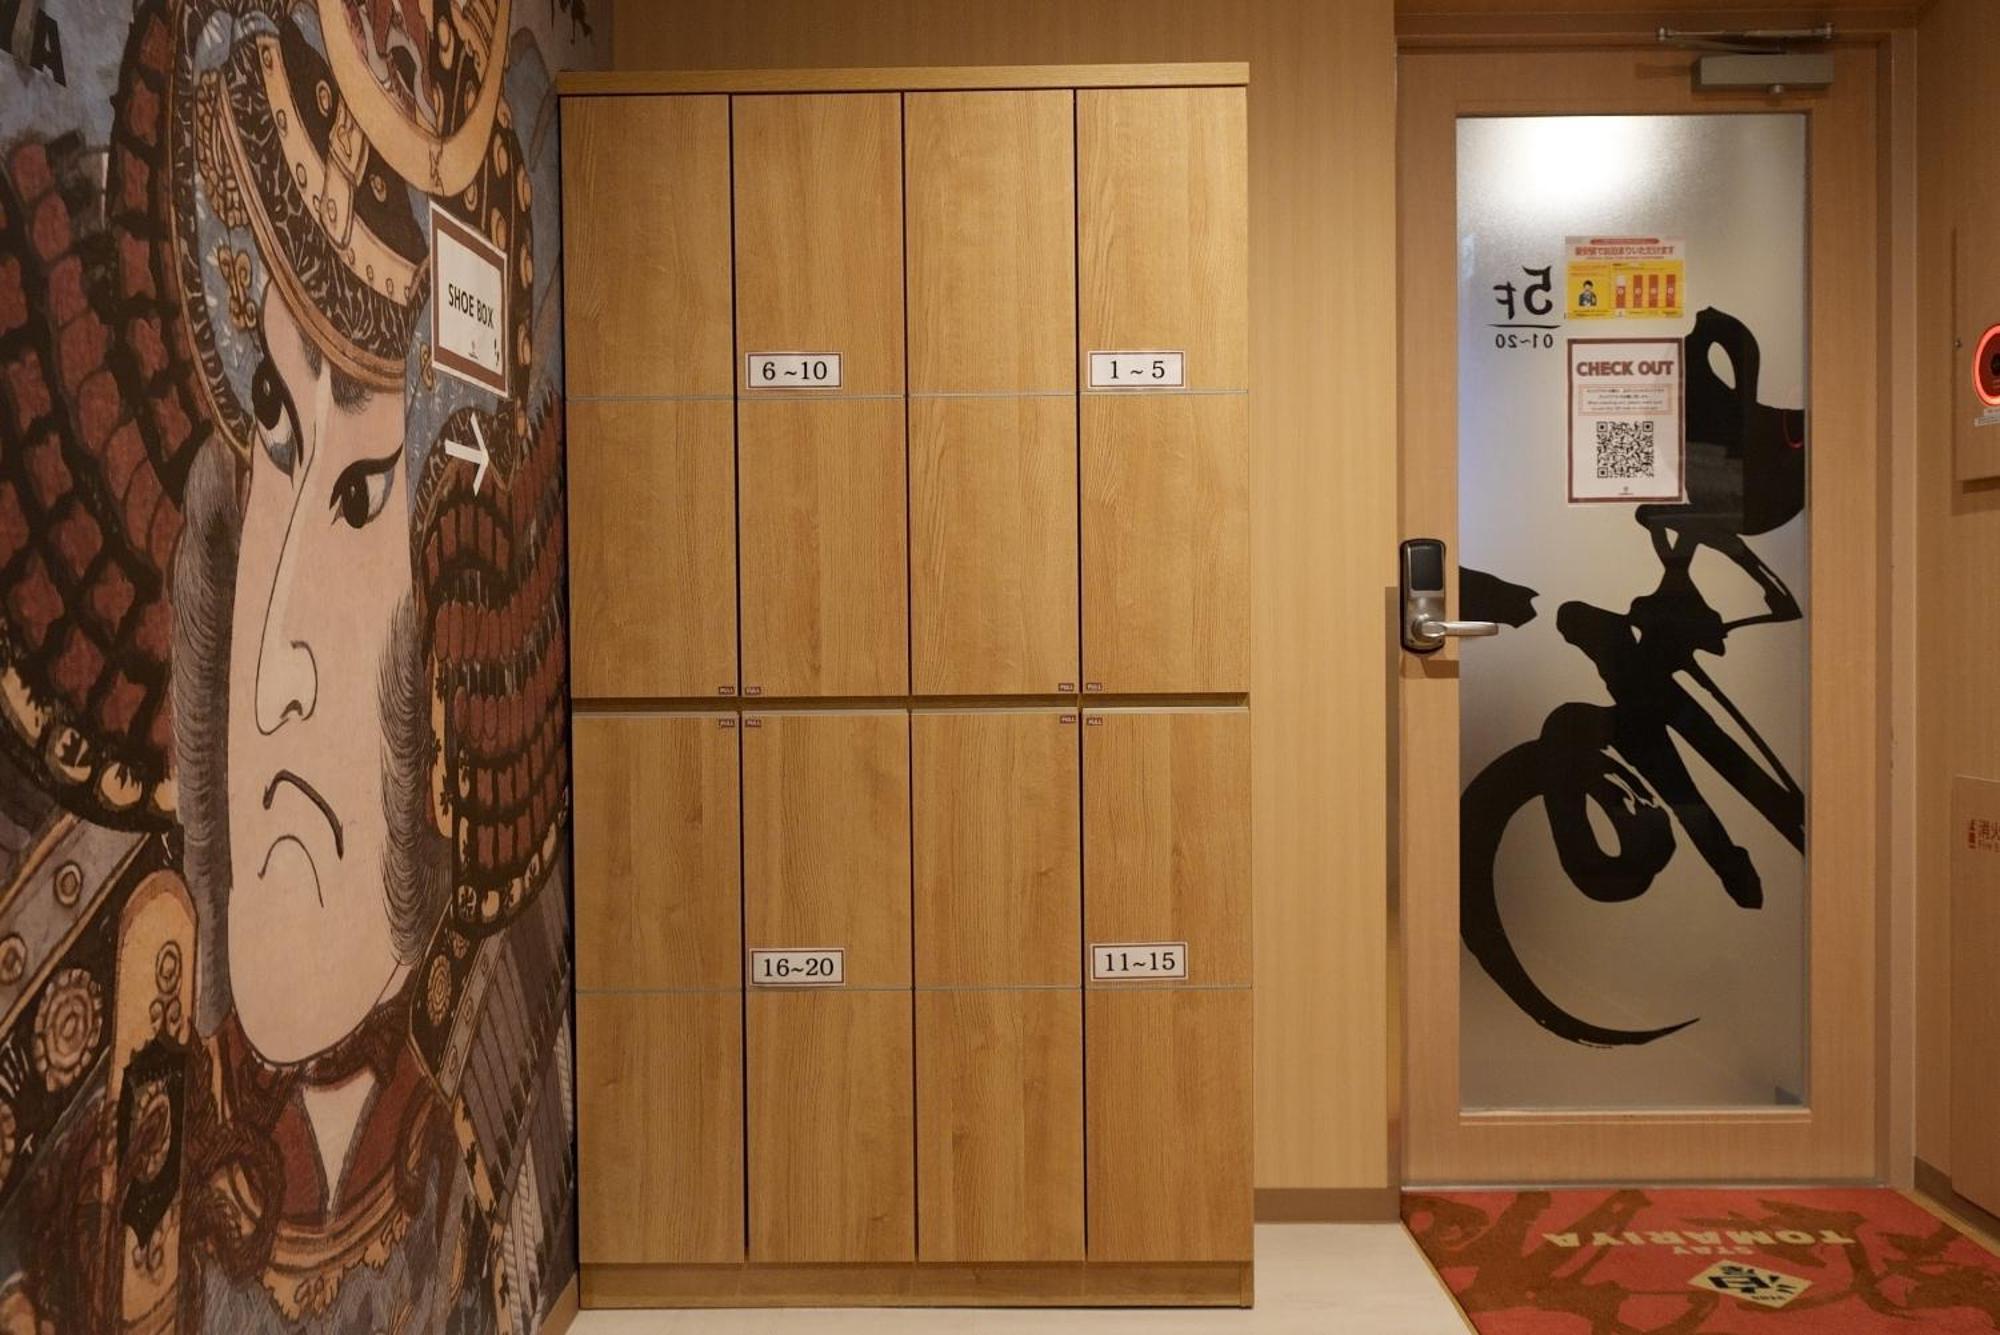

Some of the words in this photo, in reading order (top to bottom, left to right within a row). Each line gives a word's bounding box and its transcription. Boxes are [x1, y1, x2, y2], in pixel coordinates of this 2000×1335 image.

[448, 283, 474, 317] SHOE
[476, 299, 494, 329] BOX
[1576, 360, 1634, 376] CHECK
[1638, 360, 1674, 376] OUT
[763, 957, 834, 978] 16~20
[1104, 952, 1176, 972] 11~15
[1542, 1230, 1856, 1248] TOMARIYA
